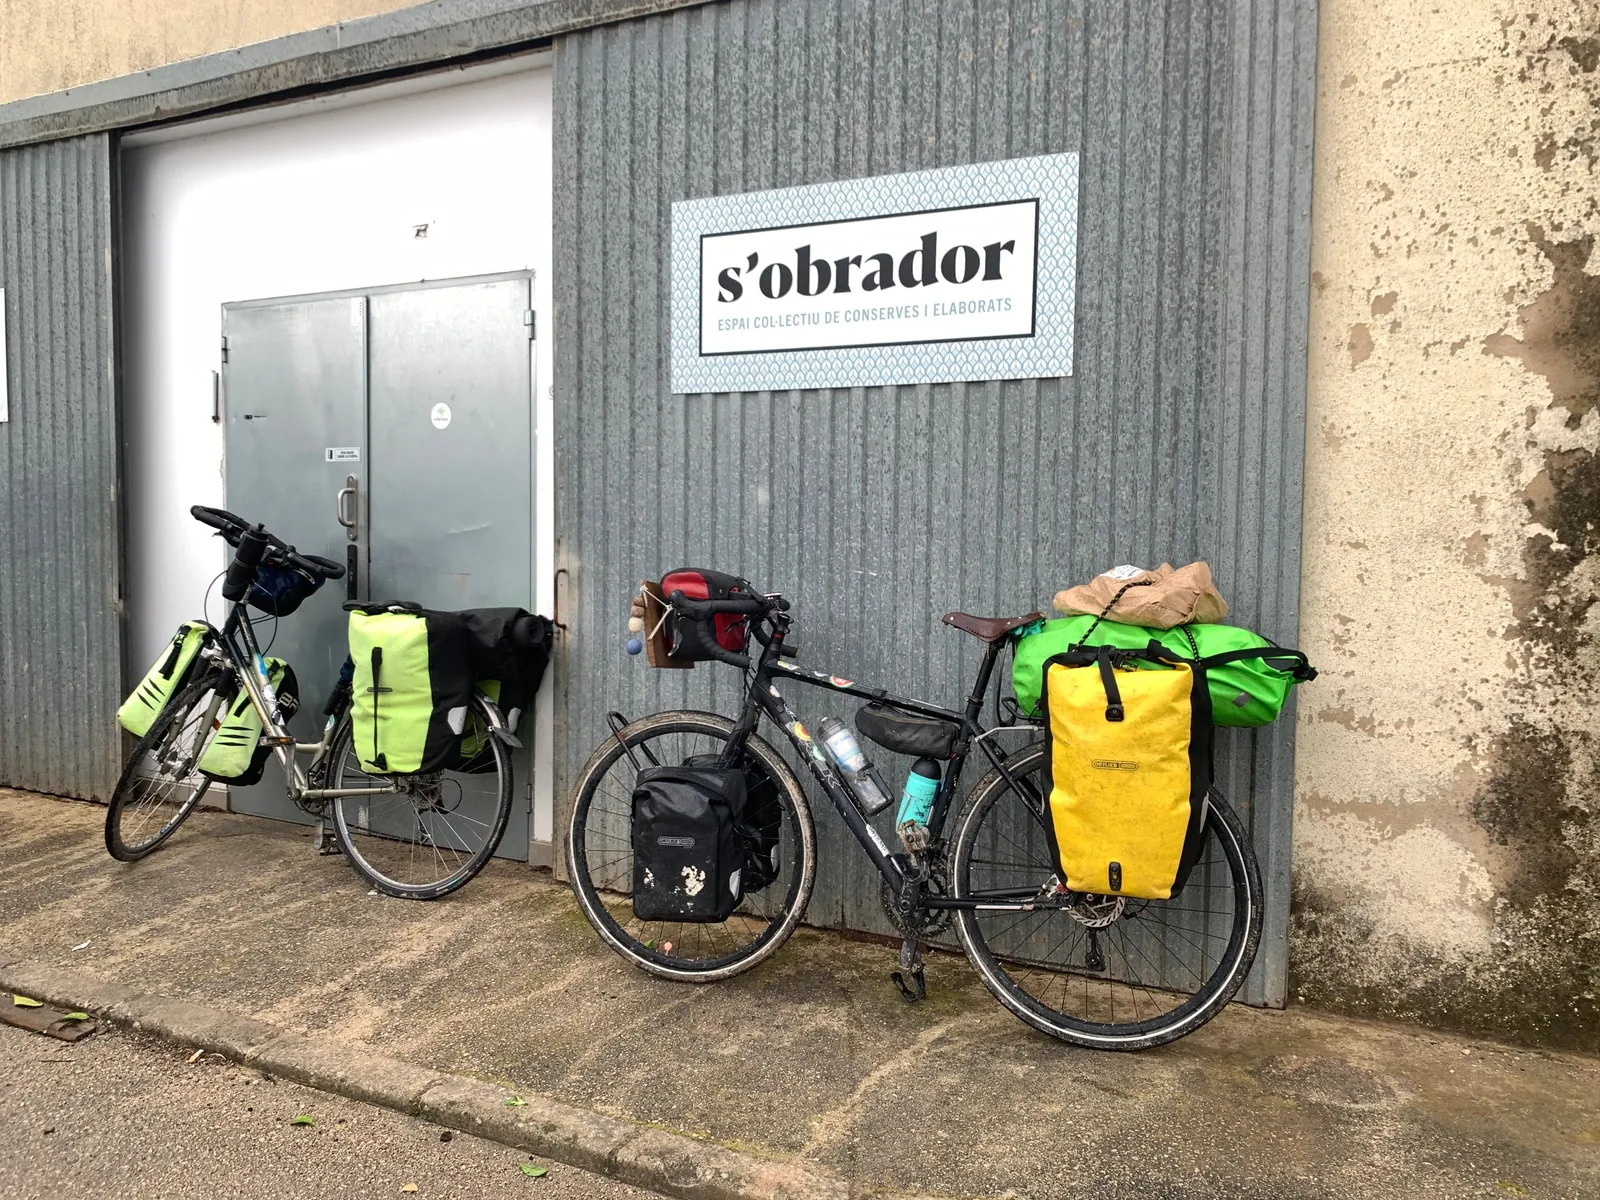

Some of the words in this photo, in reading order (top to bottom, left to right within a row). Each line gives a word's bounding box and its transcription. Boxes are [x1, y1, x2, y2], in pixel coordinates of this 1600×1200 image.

[718, 318, 750, 331] ESPAI
[824, 311, 840, 324] DE
[844, 305, 920, 323] CONSERVES
[933, 298, 1012, 317] ELABORATS
